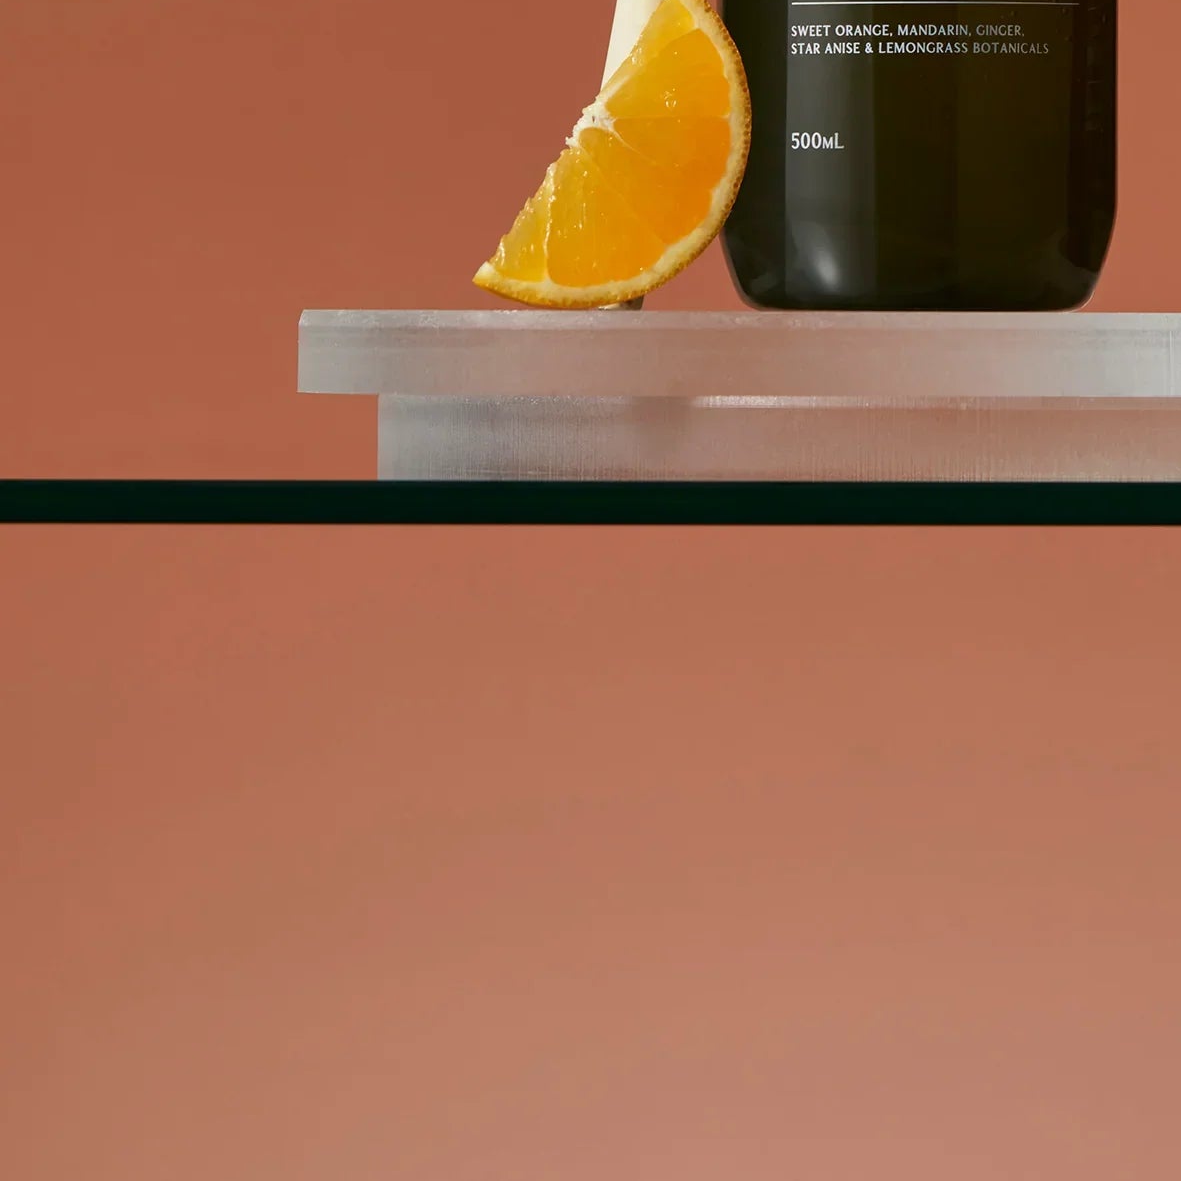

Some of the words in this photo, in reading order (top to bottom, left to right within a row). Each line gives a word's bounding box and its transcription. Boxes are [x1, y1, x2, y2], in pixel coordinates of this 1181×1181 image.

[791, 25, 831, 37] SWEET
[835, 25, 893, 38] ORANGE,
[897, 25, 971, 38] MANDARIN,
[976, 25, 1024, 38] GINGER,
[791, 43, 820, 54] STAR
[825, 43, 860, 54] ANISE
[865, 43, 873, 54] &
[879, 42, 968, 53] LEMONGRASS
[973, 43, 1048, 54] BOTANICALS
